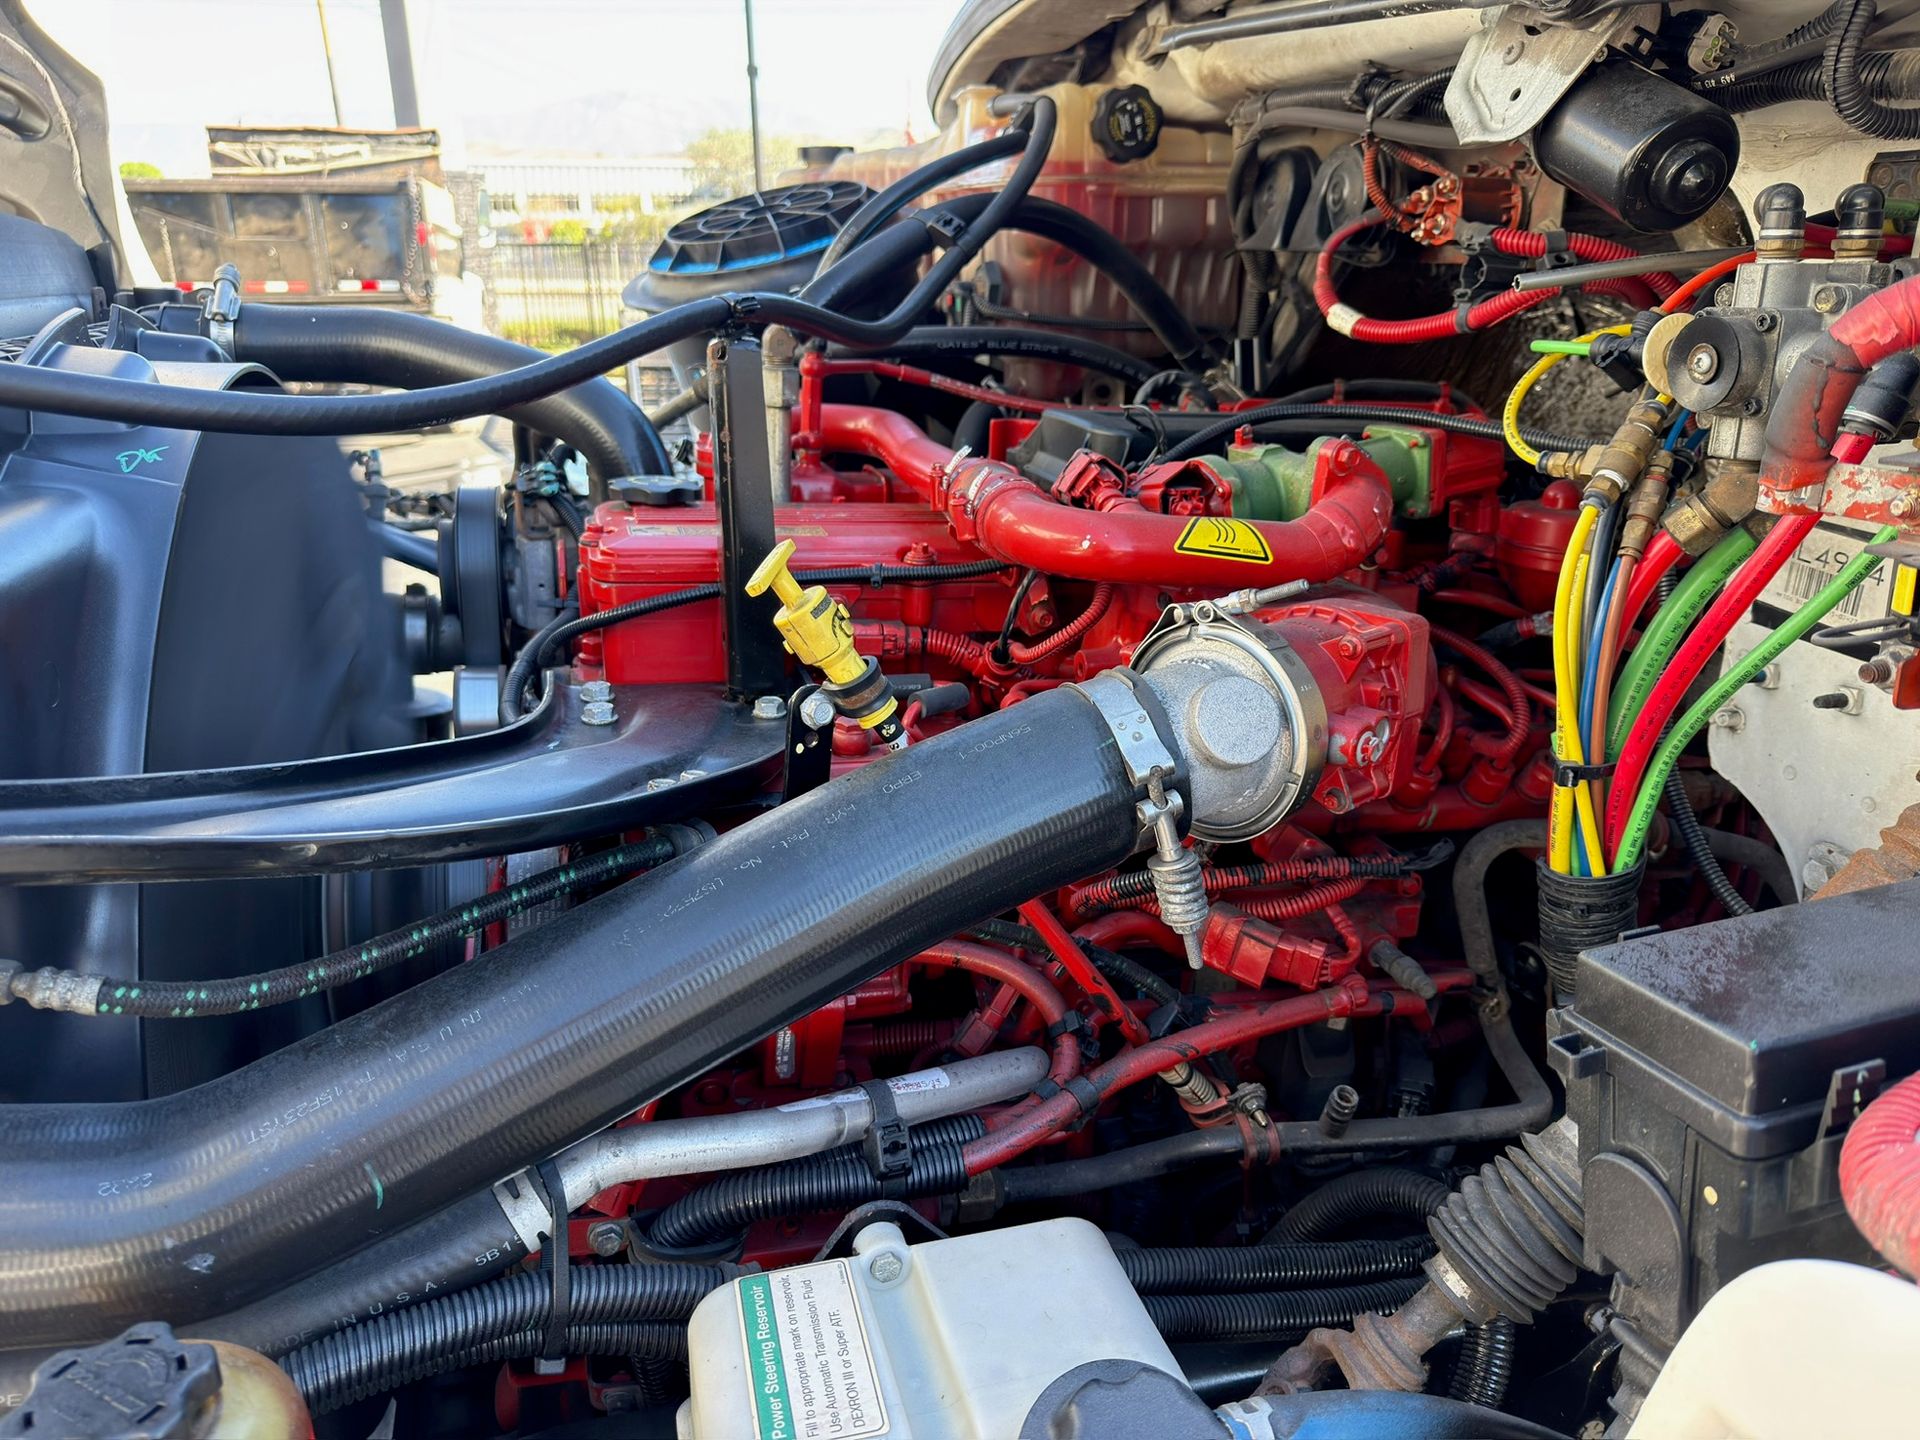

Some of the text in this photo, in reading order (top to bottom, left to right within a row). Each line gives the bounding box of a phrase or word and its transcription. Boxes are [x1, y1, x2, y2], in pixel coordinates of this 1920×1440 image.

[987, 341, 1017, 350] BLUE
[333, 1313, 358, 1331] IN
[750, 1286, 787, 1440] Power Steering Reservoir
[779, 1274, 820, 1438] Fill to appropriate mark on reservoir.
[800, 1279, 843, 1434] Use Automatic Transmission Fluid
[828, 1309, 866, 1428] DEXRON III or Super ATF.
